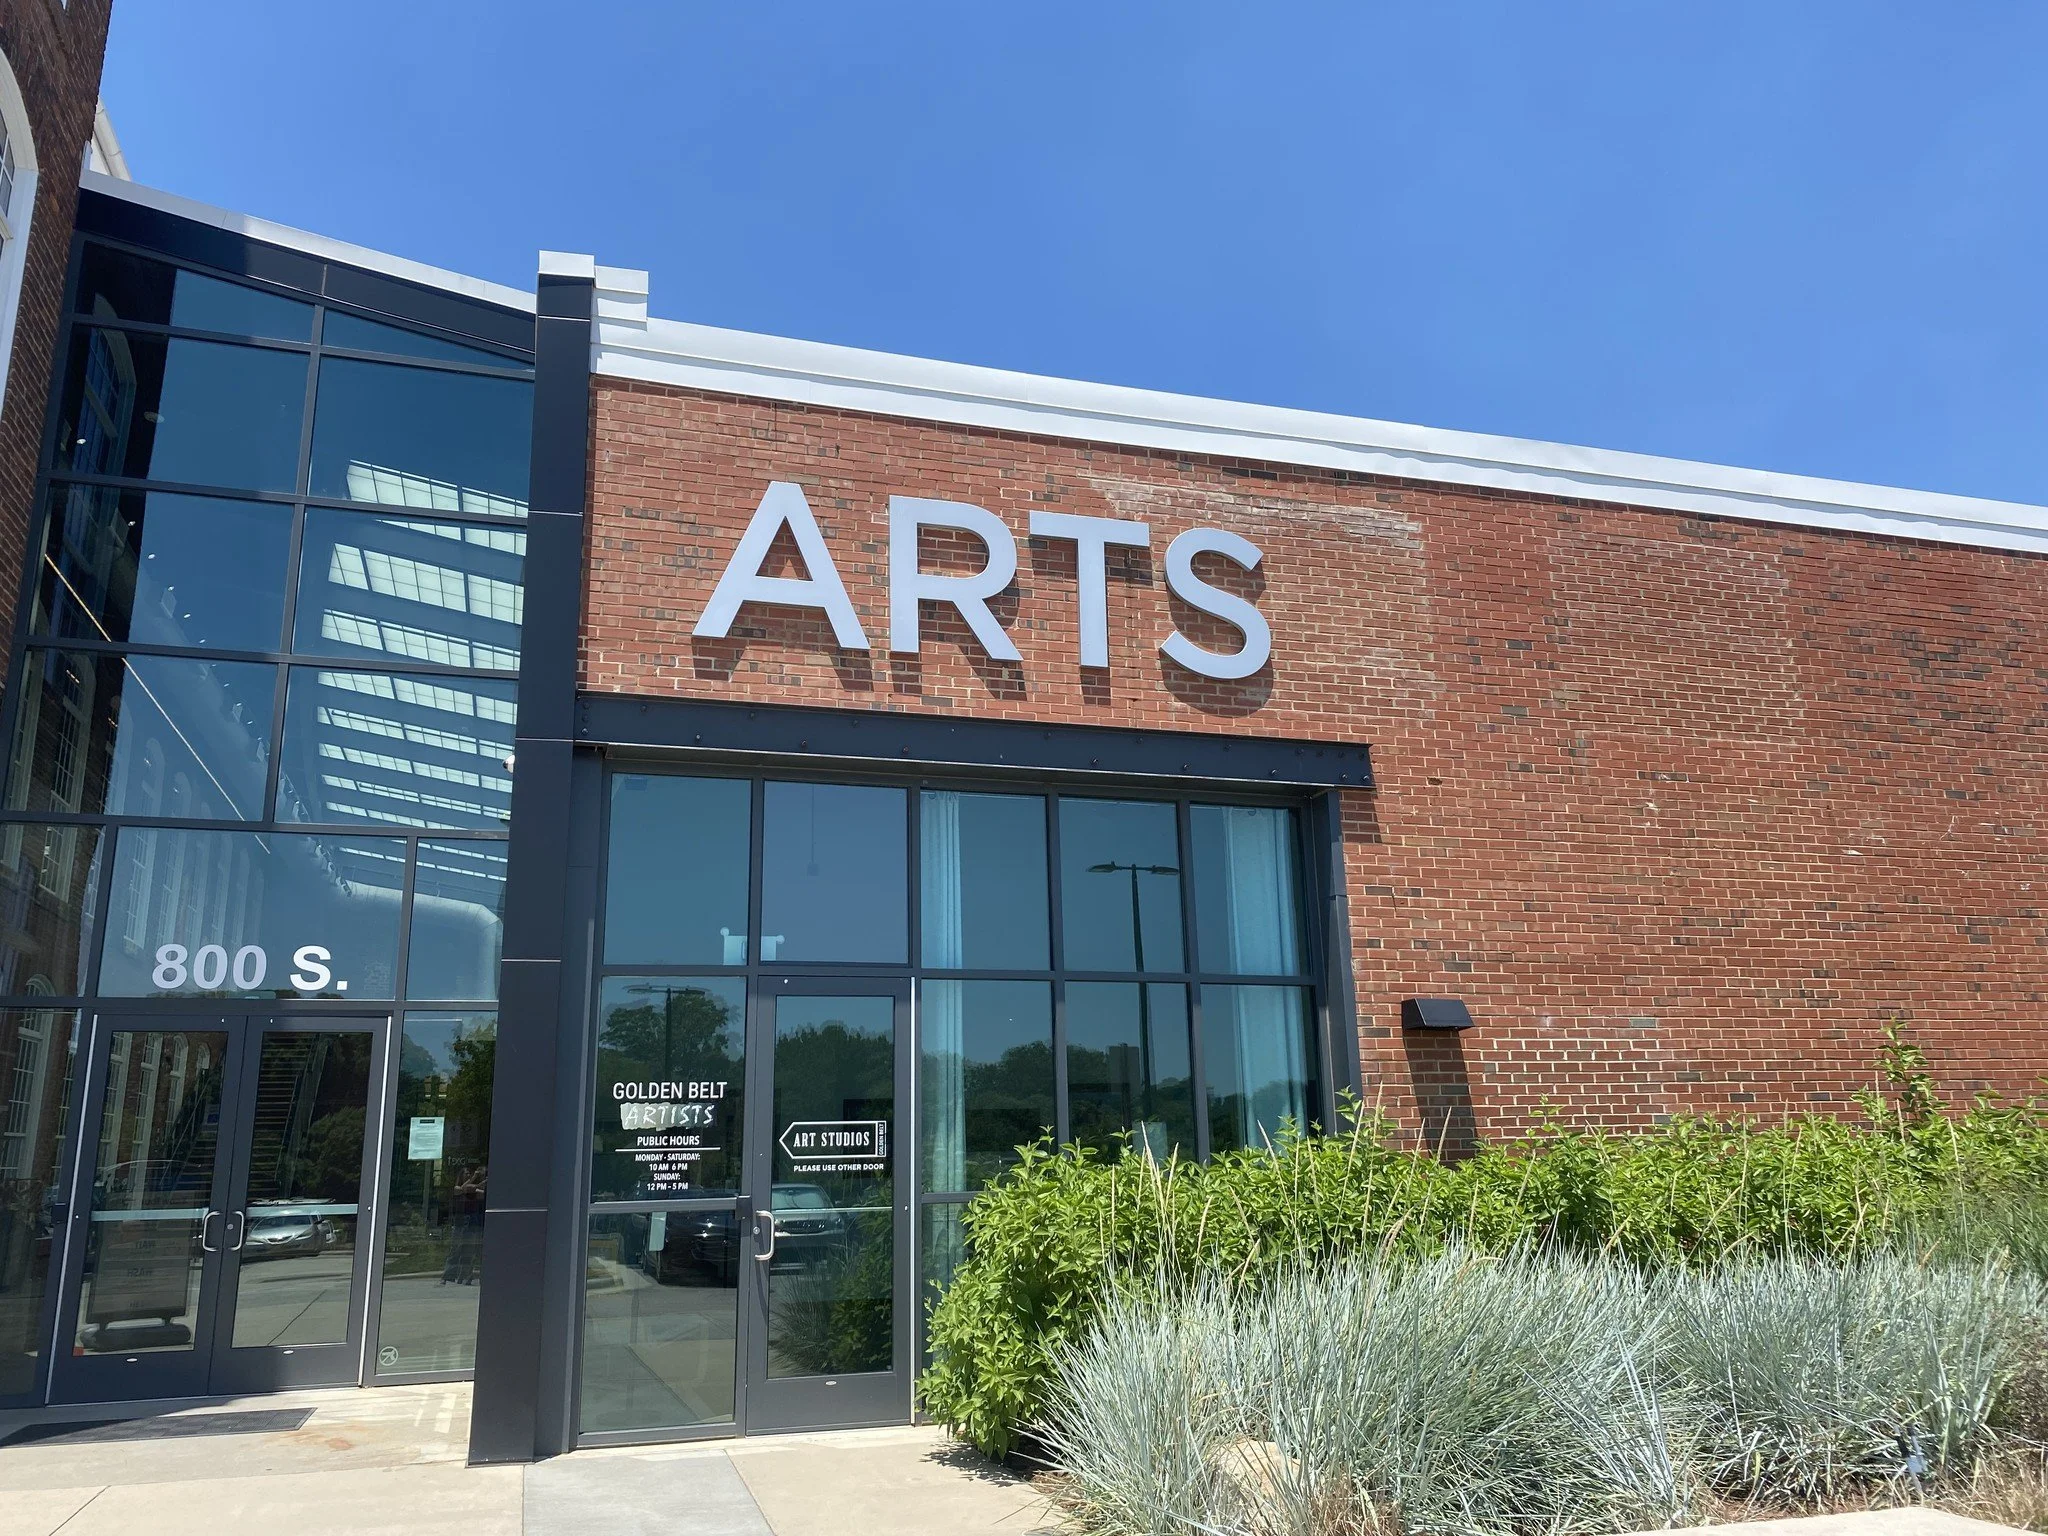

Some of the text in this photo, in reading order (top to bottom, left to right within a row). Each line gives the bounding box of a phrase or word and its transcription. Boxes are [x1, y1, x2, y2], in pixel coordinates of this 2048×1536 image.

[692, 481, 1272, 680] ARTS
[152, 943, 348, 991] 800 S.
[613, 1081, 728, 1100] GOLDEN BELT
[624, 1104, 715, 1126] ARTISTS
[637, 1135, 700, 1146] PUBLIC HOURS
[793, 1131, 870, 1147] ART STUDIOS
[635, 1153, 663, 1162] MONDAY
[667, 1153, 701, 1161] SATURDAY:
[649, 1163, 657, 1171] 10
[658, 1163, 669, 1171] AM
[793, 1164, 821, 1172] PLEASE
[822, 1163, 836, 1171] USE
[653, 1173, 681, 1181] SUNDAY:
[647, 1183, 655, 1191] 12
[678, 1182, 688, 1190] PM
